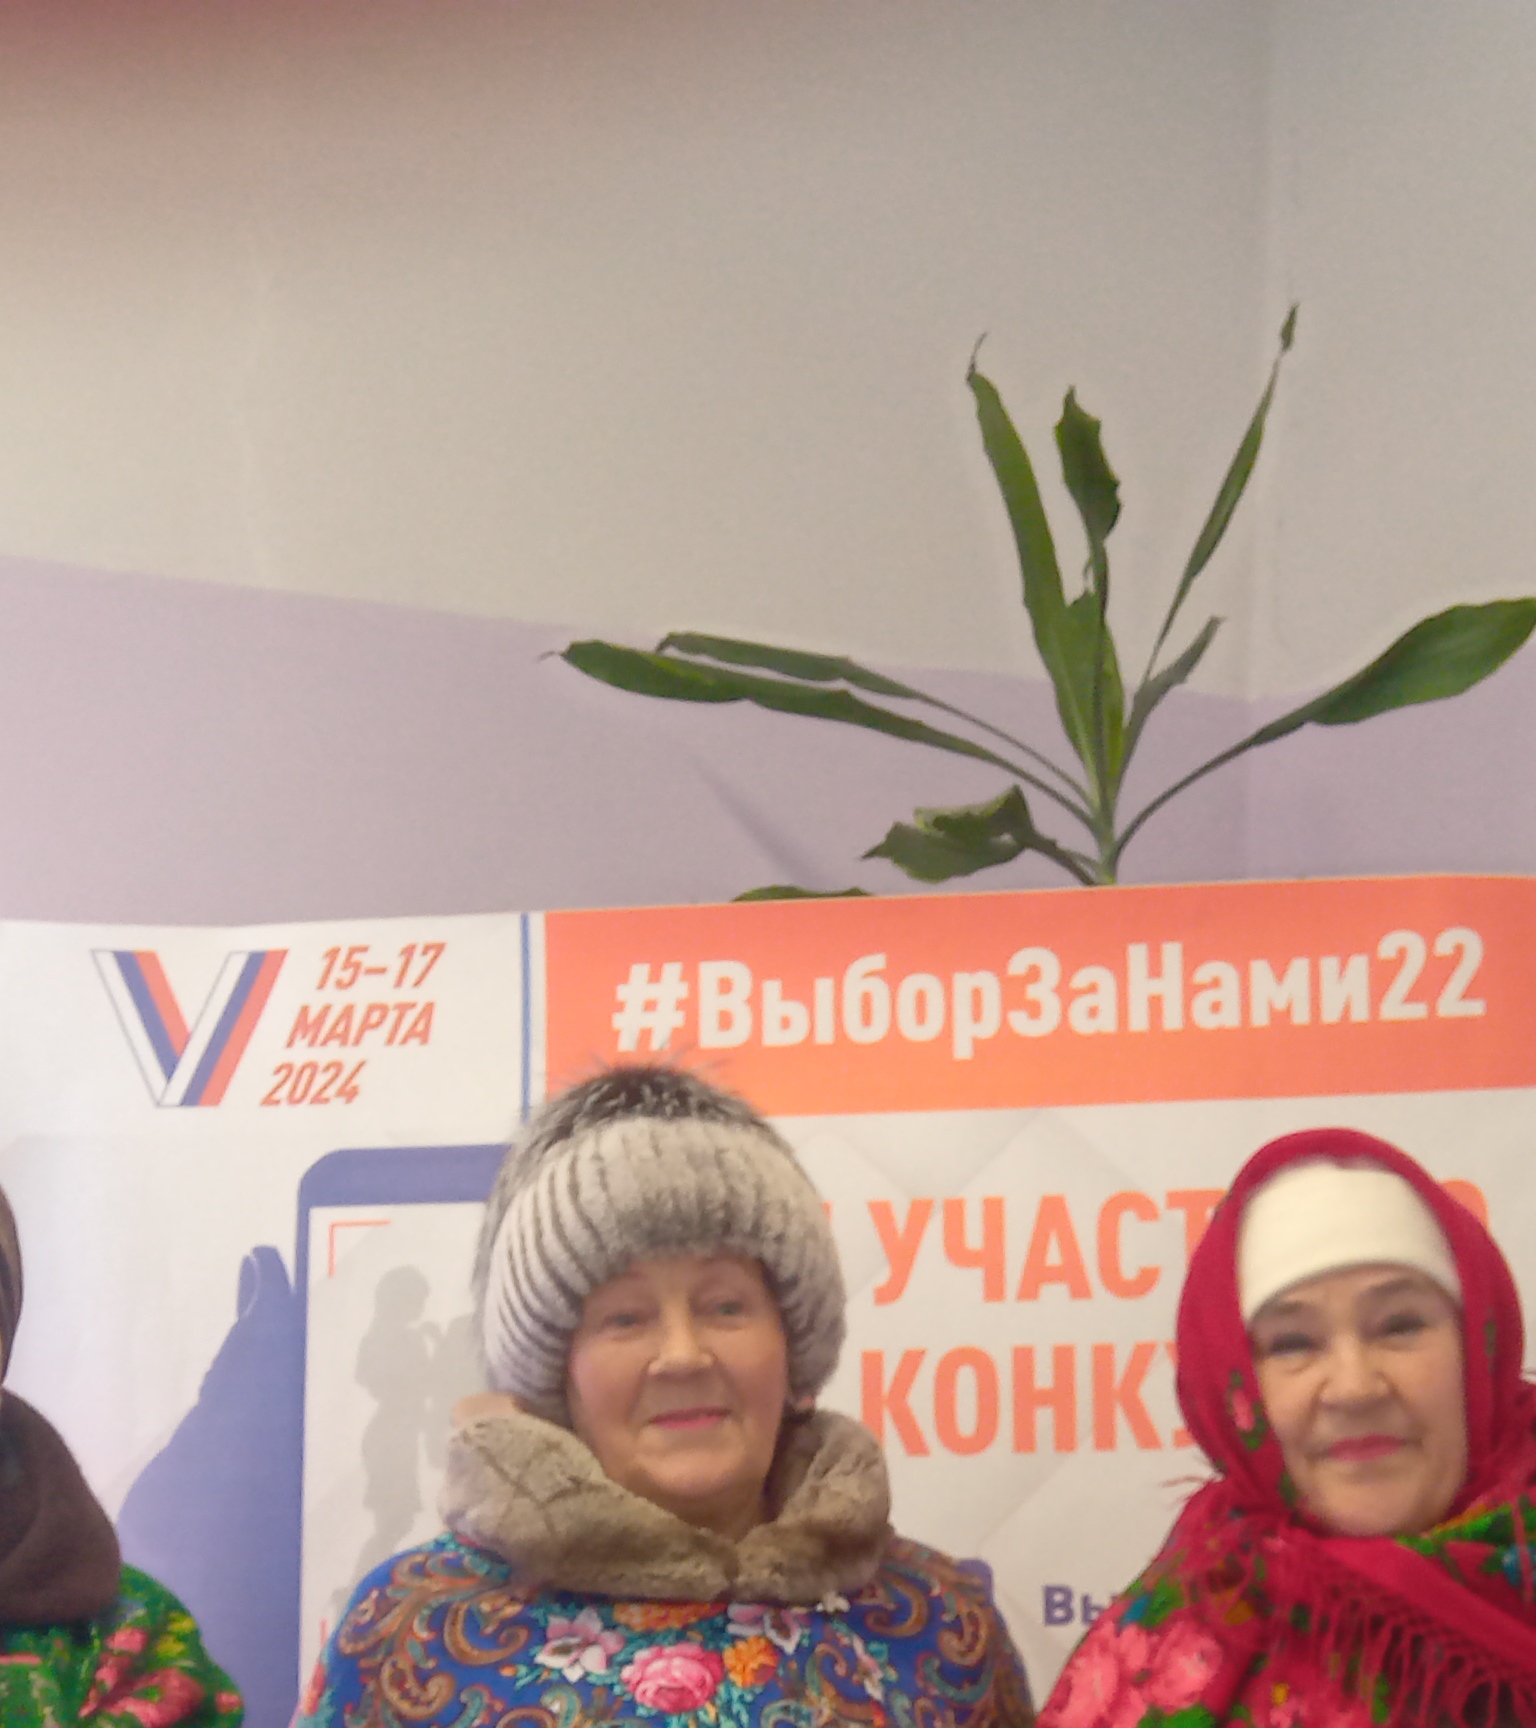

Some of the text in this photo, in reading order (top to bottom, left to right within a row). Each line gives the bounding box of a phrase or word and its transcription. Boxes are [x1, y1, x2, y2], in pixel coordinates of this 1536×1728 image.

[612, 927, 1487, 1060] #ВыборЗаНами22
[286, 1002, 436, 1049] МАРТА
[260, 1061, 366, 1106] 2024
